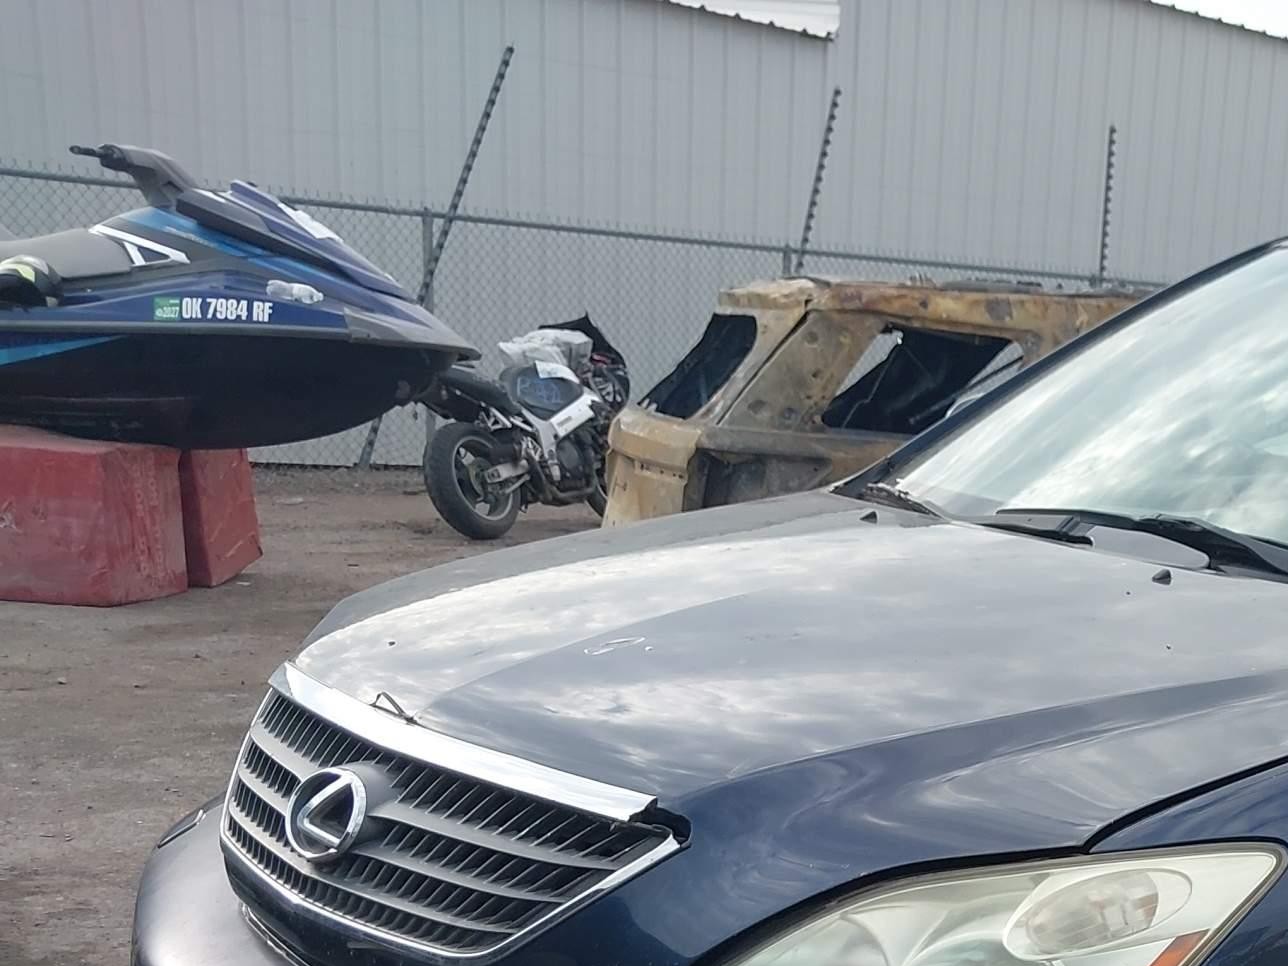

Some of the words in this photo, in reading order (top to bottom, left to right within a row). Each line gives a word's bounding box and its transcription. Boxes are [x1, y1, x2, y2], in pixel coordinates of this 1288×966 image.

[182, 297, 202, 319] OK
[206, 298, 248, 320] 7984
[252, 300, 273, 322] RF
